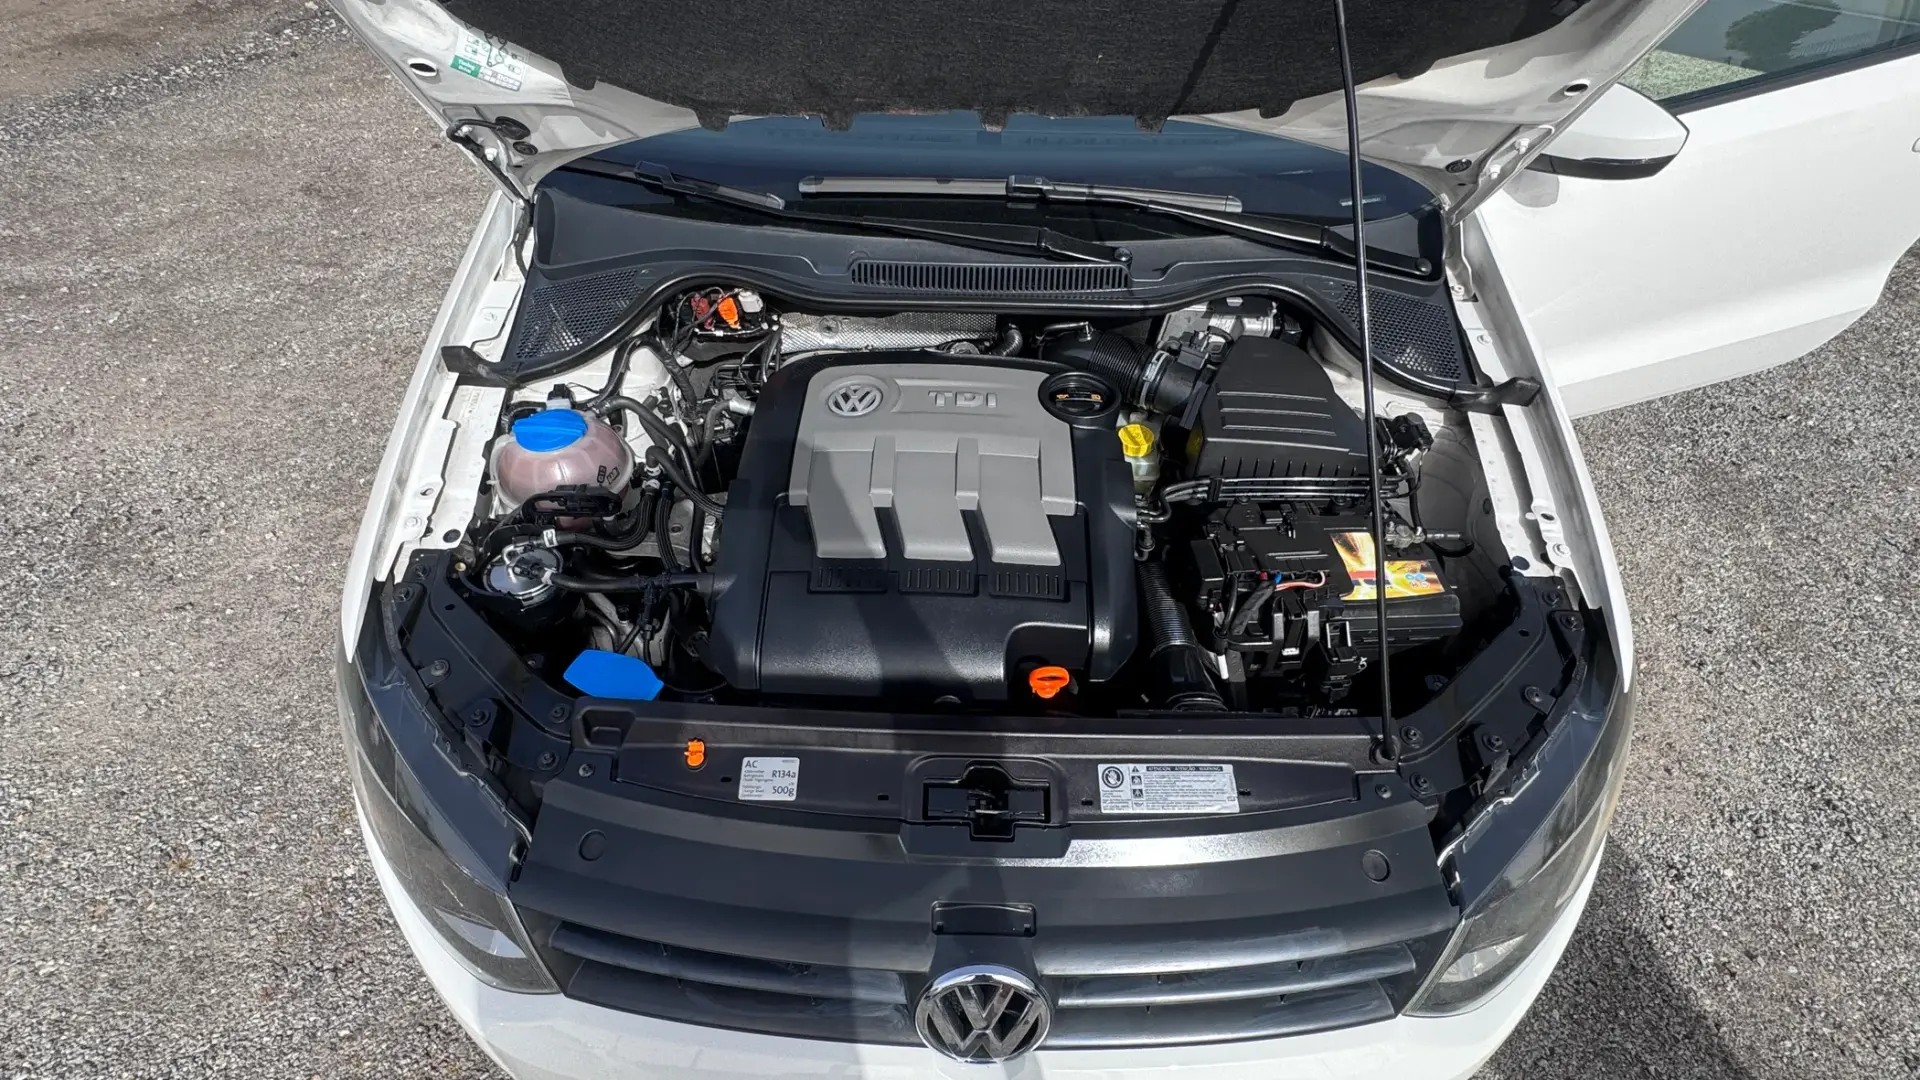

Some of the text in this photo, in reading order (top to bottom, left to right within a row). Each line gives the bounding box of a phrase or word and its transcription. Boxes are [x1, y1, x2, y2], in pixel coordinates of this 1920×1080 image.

[928, 391, 997, 408] TDI
[744, 760, 758, 769] AC
[771, 769, 796, 778] R134a
[771, 786, 795, 797] 500g
